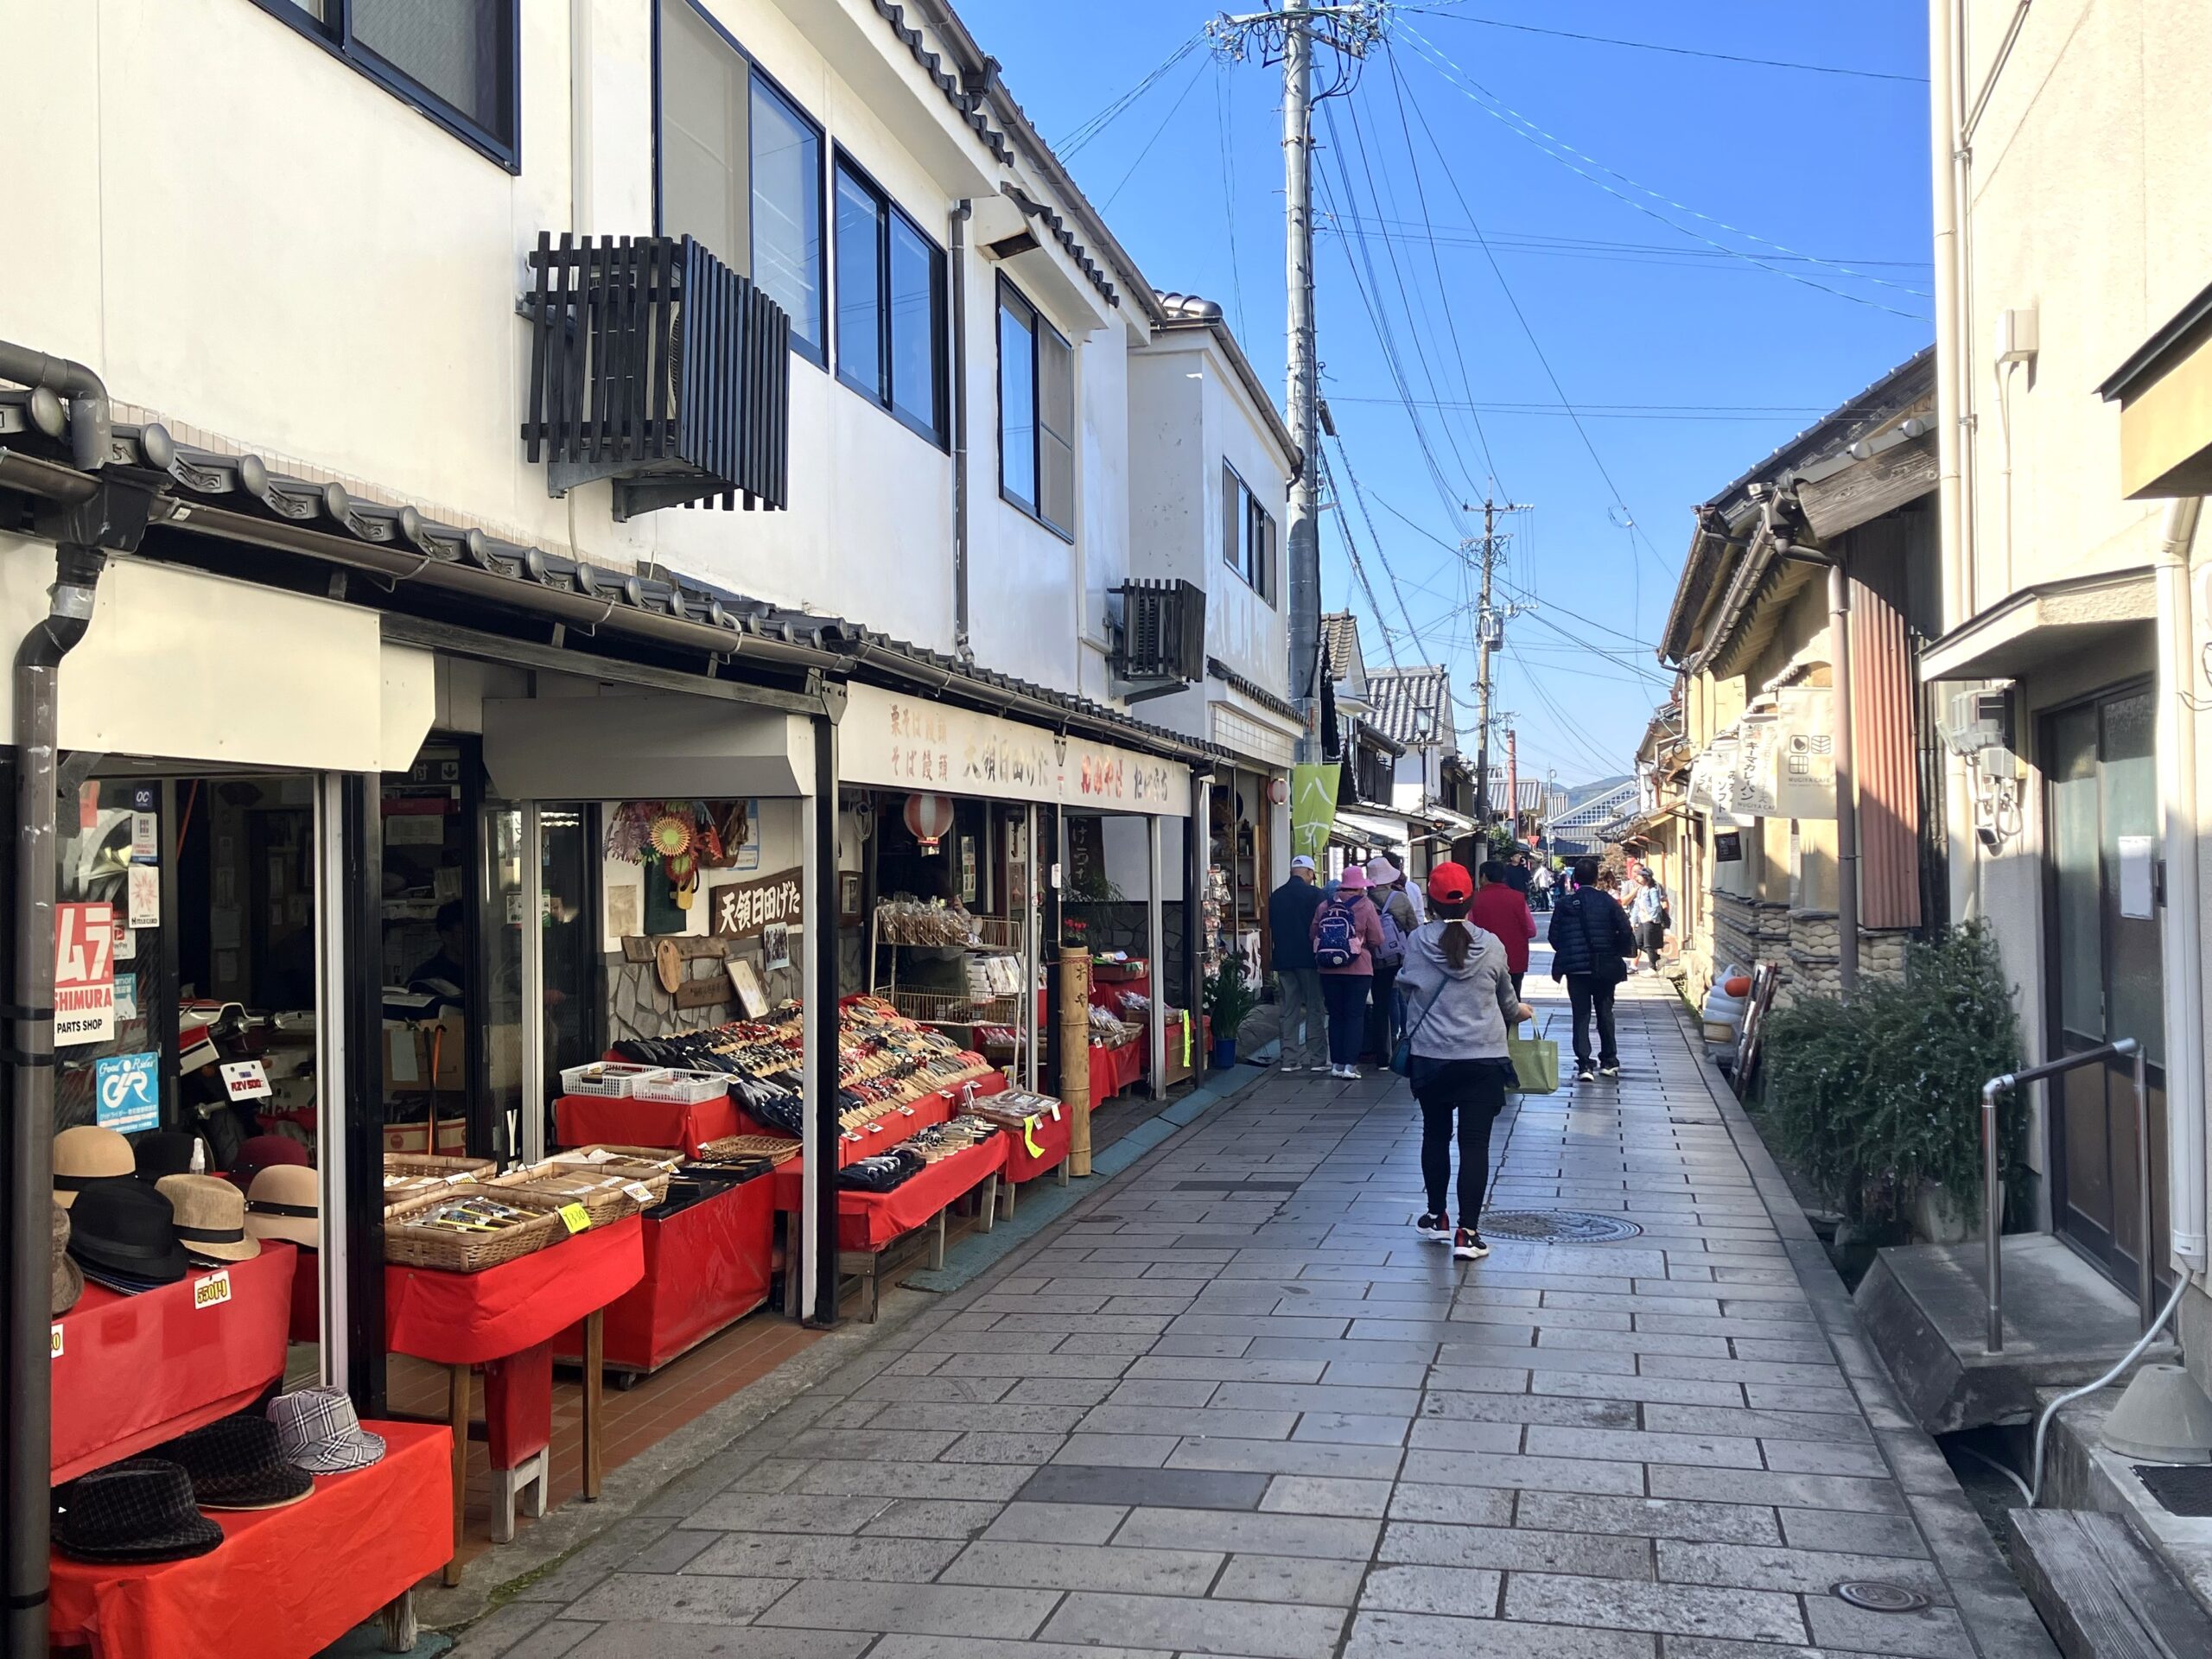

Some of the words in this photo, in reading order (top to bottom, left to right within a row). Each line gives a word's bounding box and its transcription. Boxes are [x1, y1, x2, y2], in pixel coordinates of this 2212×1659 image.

[1740, 741, 1759, 802] キーマカレーパン
[1718, 781, 1727, 813] ソフト
[720, 880, 801, 934] 天領日田げた
[57, 1020, 81, 1034] PARTS
[82, 1019, 103, 1031] SHOP
[197, 1279, 227, 1304] 550円
